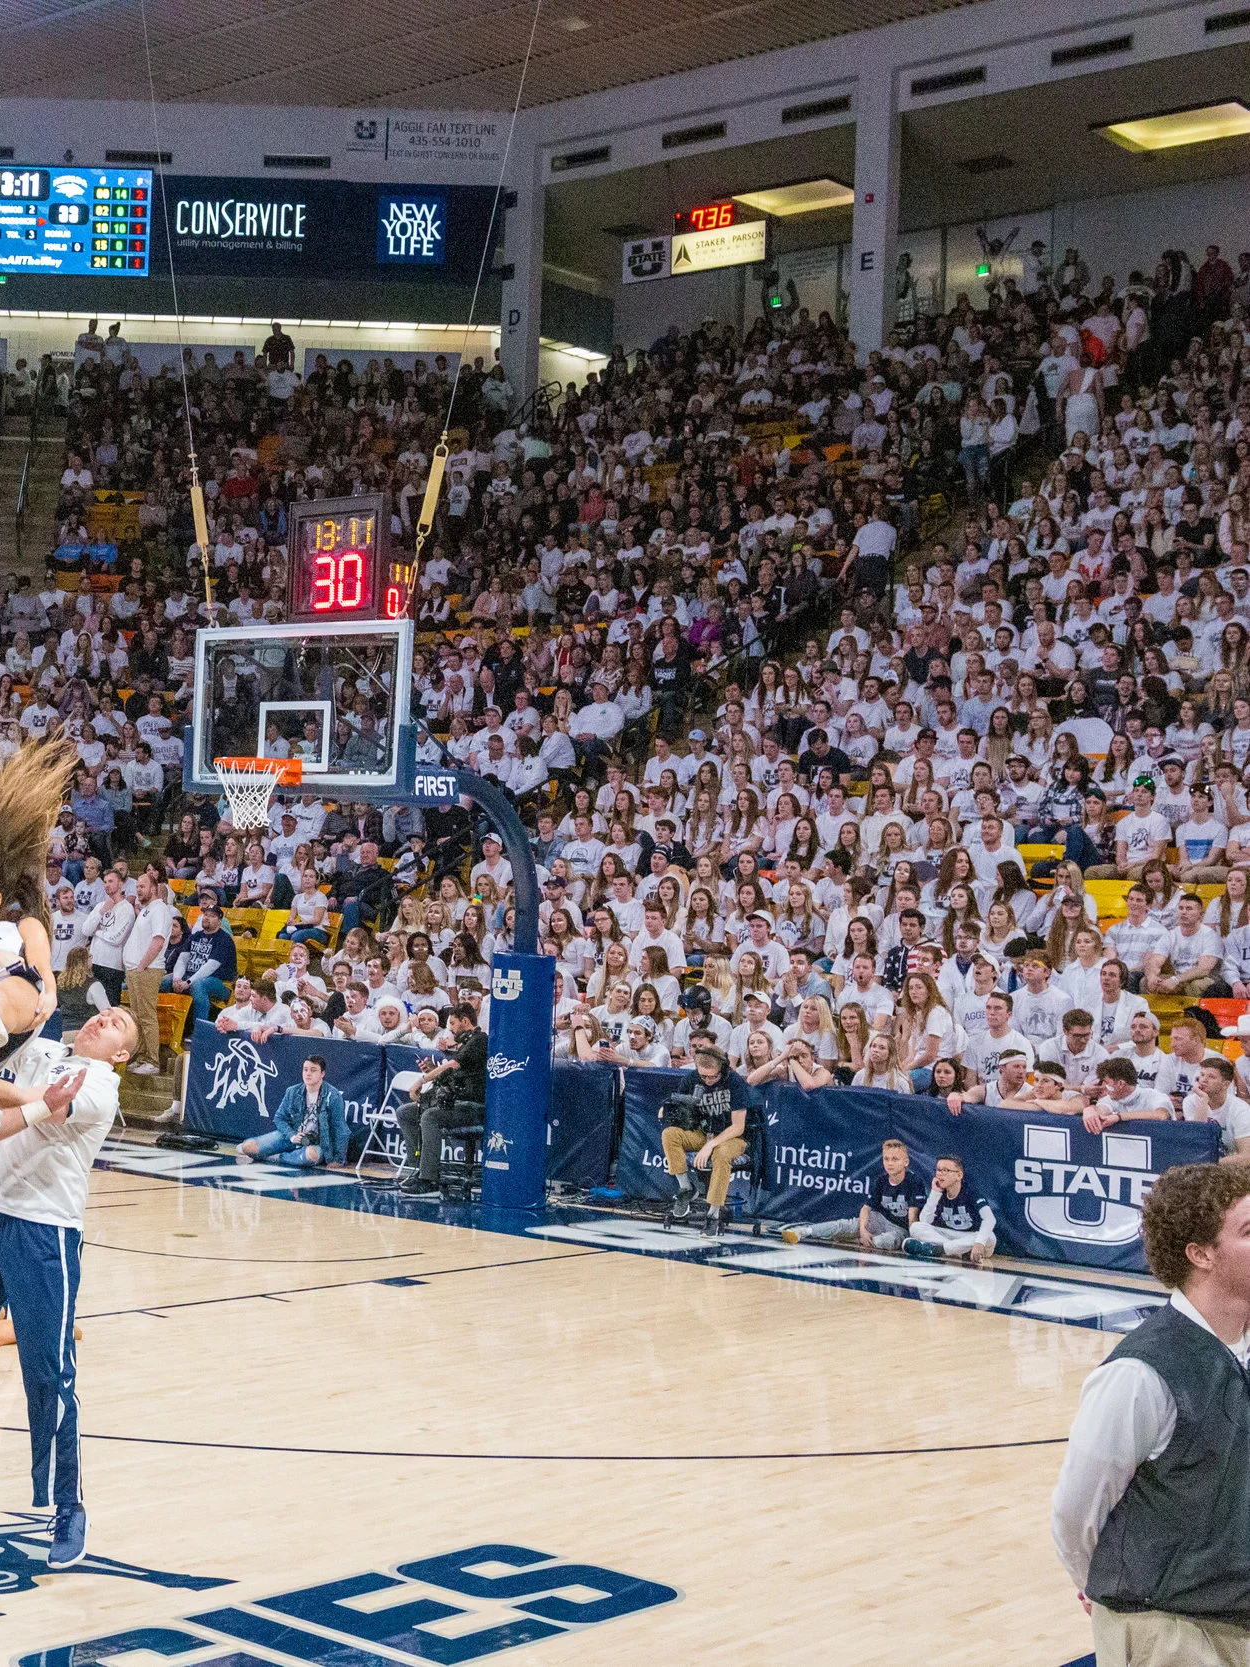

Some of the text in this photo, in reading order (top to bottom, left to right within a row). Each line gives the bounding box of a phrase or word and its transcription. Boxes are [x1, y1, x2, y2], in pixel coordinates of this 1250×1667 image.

[394, 121, 496, 136] AGGIE FAN TEXT LINE
[115, 189, 127, 199] 14
[28, 205, 35, 214] 2
[390, 203, 437, 220] NEW
[381, 219, 441, 240] YORK
[177, 239, 199, 249] utility
[202, 240, 264, 250] management
[276, 240, 303, 252] billing
[389, 237, 434, 256] LIFE
[696, 230, 764, 249] STAKER PARSON
[628, 252, 666, 268] STATE
[861, 252, 875, 271] E
[509, 309, 520, 326] D
[316, 519, 373, 550] 13:11
[314, 554, 362, 609] 30
[415, 776, 456, 797] FIRST
